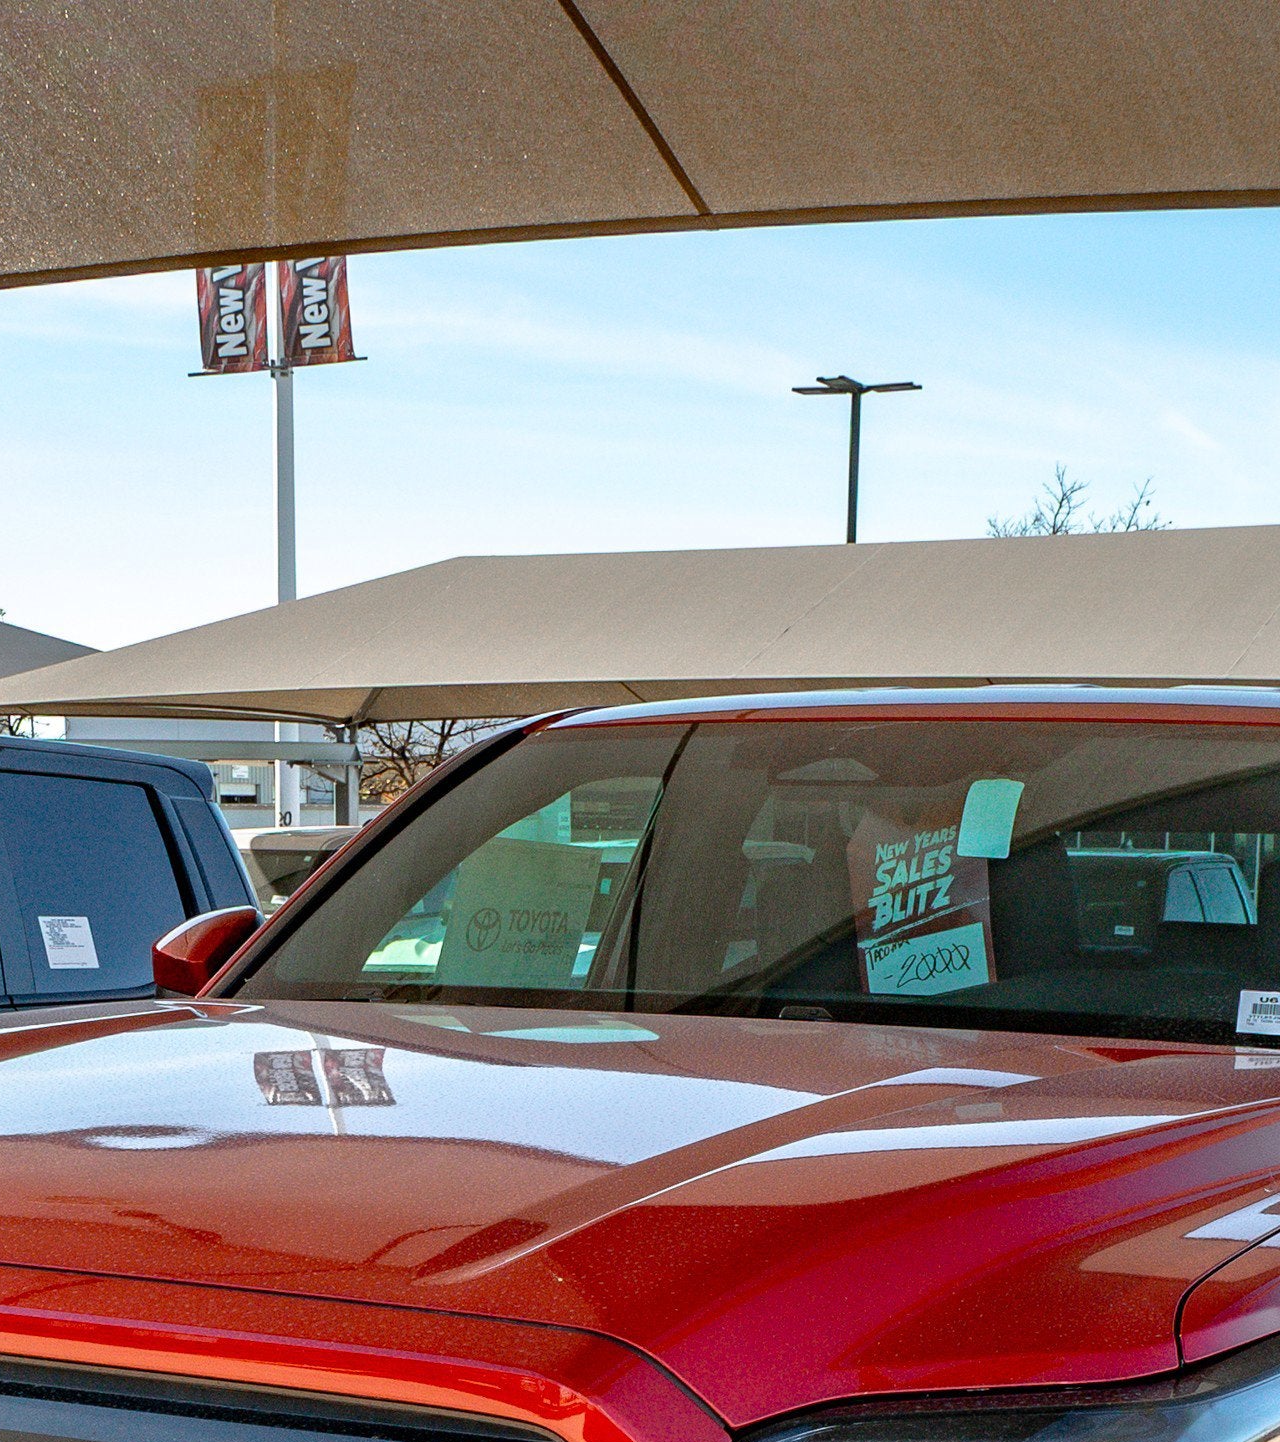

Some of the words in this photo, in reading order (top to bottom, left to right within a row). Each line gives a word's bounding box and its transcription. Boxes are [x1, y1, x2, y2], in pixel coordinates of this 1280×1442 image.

[216, 287, 248, 358] New
[299, 277, 332, 349] New
[873, 845, 953, 897] SALES
[875, 840, 909, 865] NEW
[914, 825, 957, 850] YEARS
[509, 909, 568, 934] TOYOTA
[867, 874, 954, 932] BLITZ
